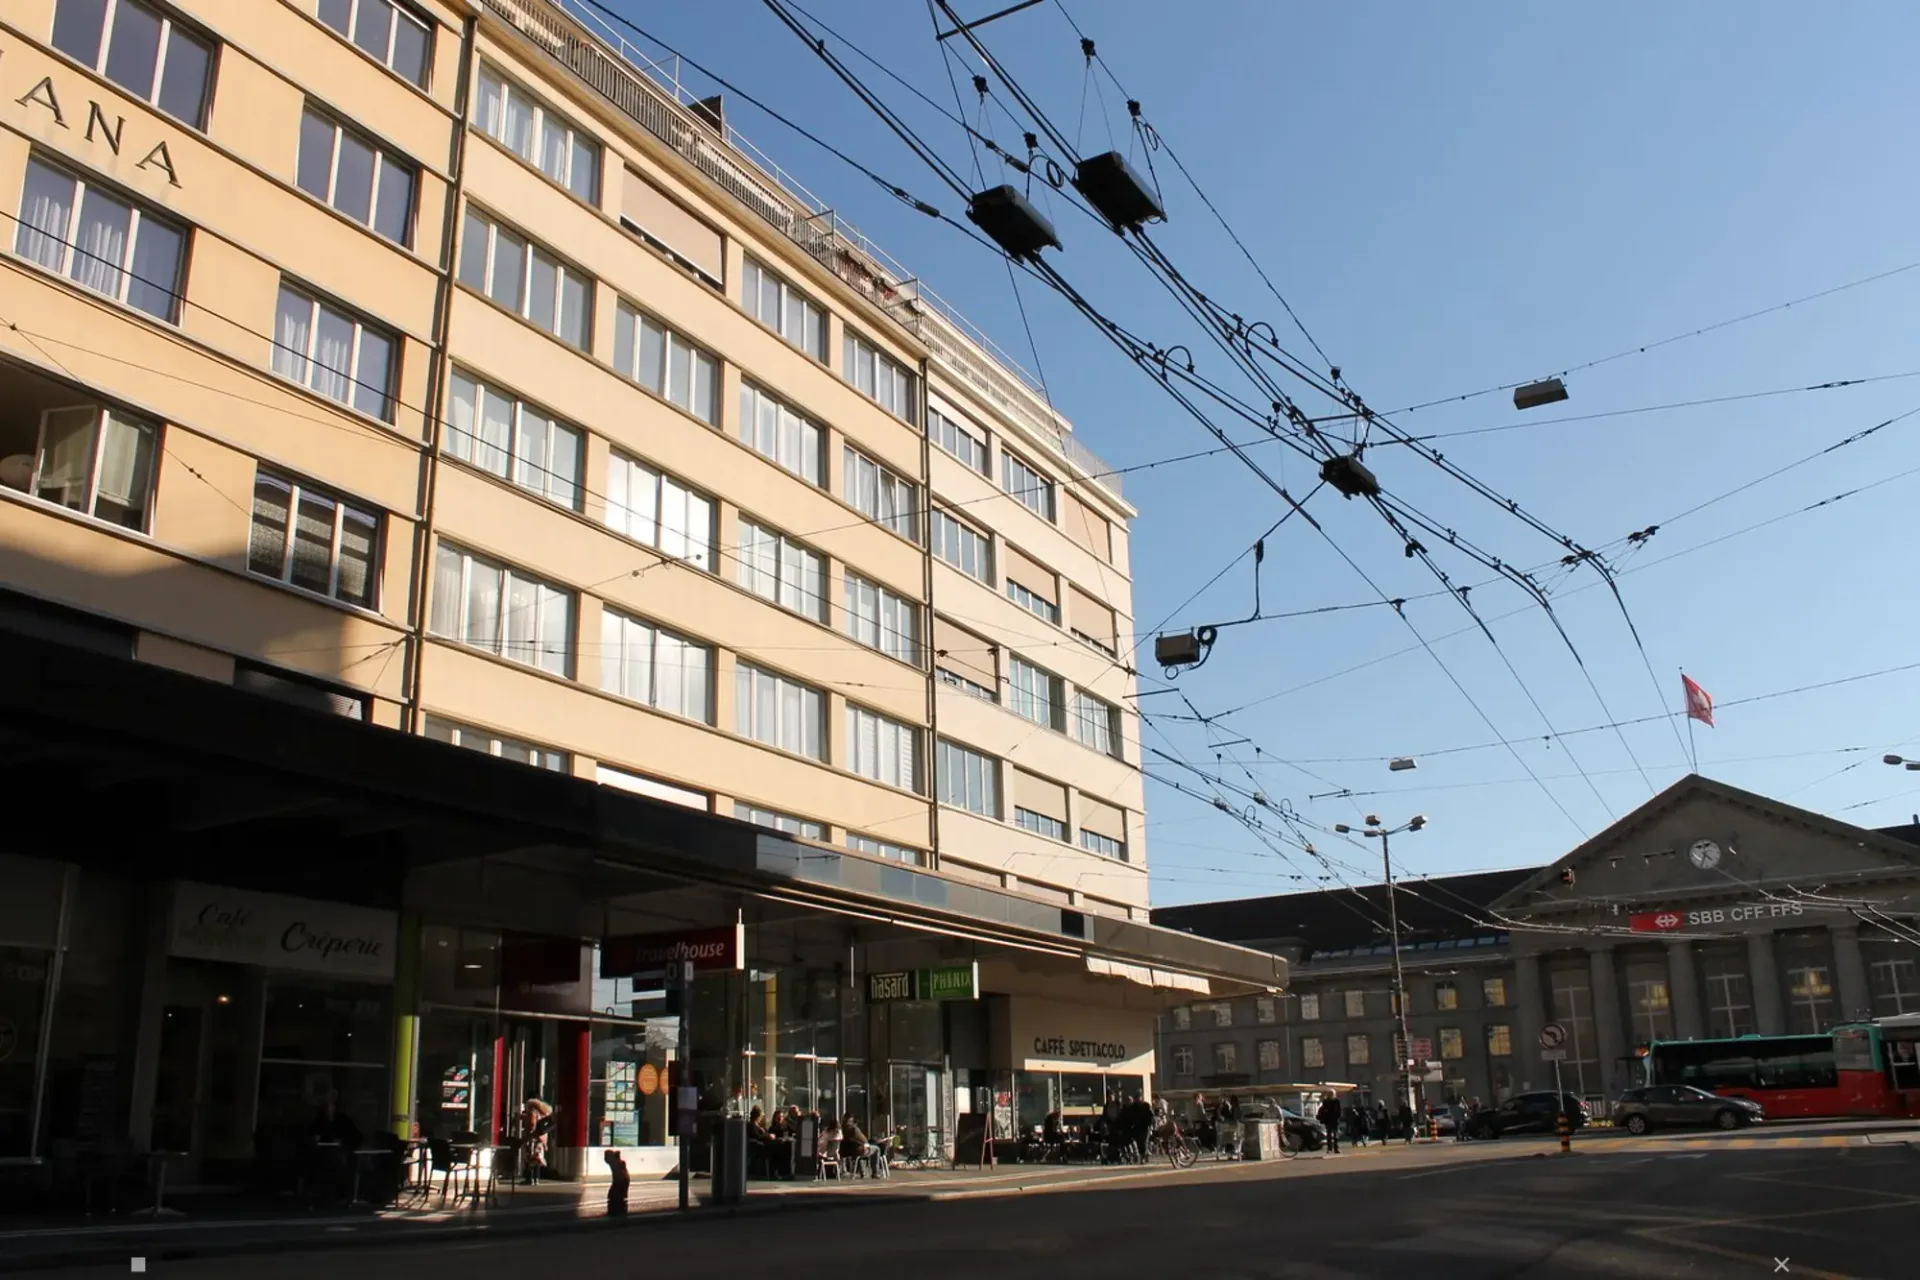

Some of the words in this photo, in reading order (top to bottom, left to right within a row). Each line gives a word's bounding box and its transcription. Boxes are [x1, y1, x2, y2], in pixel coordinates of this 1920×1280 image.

[0, 48, 182, 189] ANA
[1688, 910, 1725, 926] SBB
[1731, 906, 1764, 922] CFF
[1771, 903, 1804, 918] FFS
[1069, 1039, 1126, 1059] SPETTACOLO
